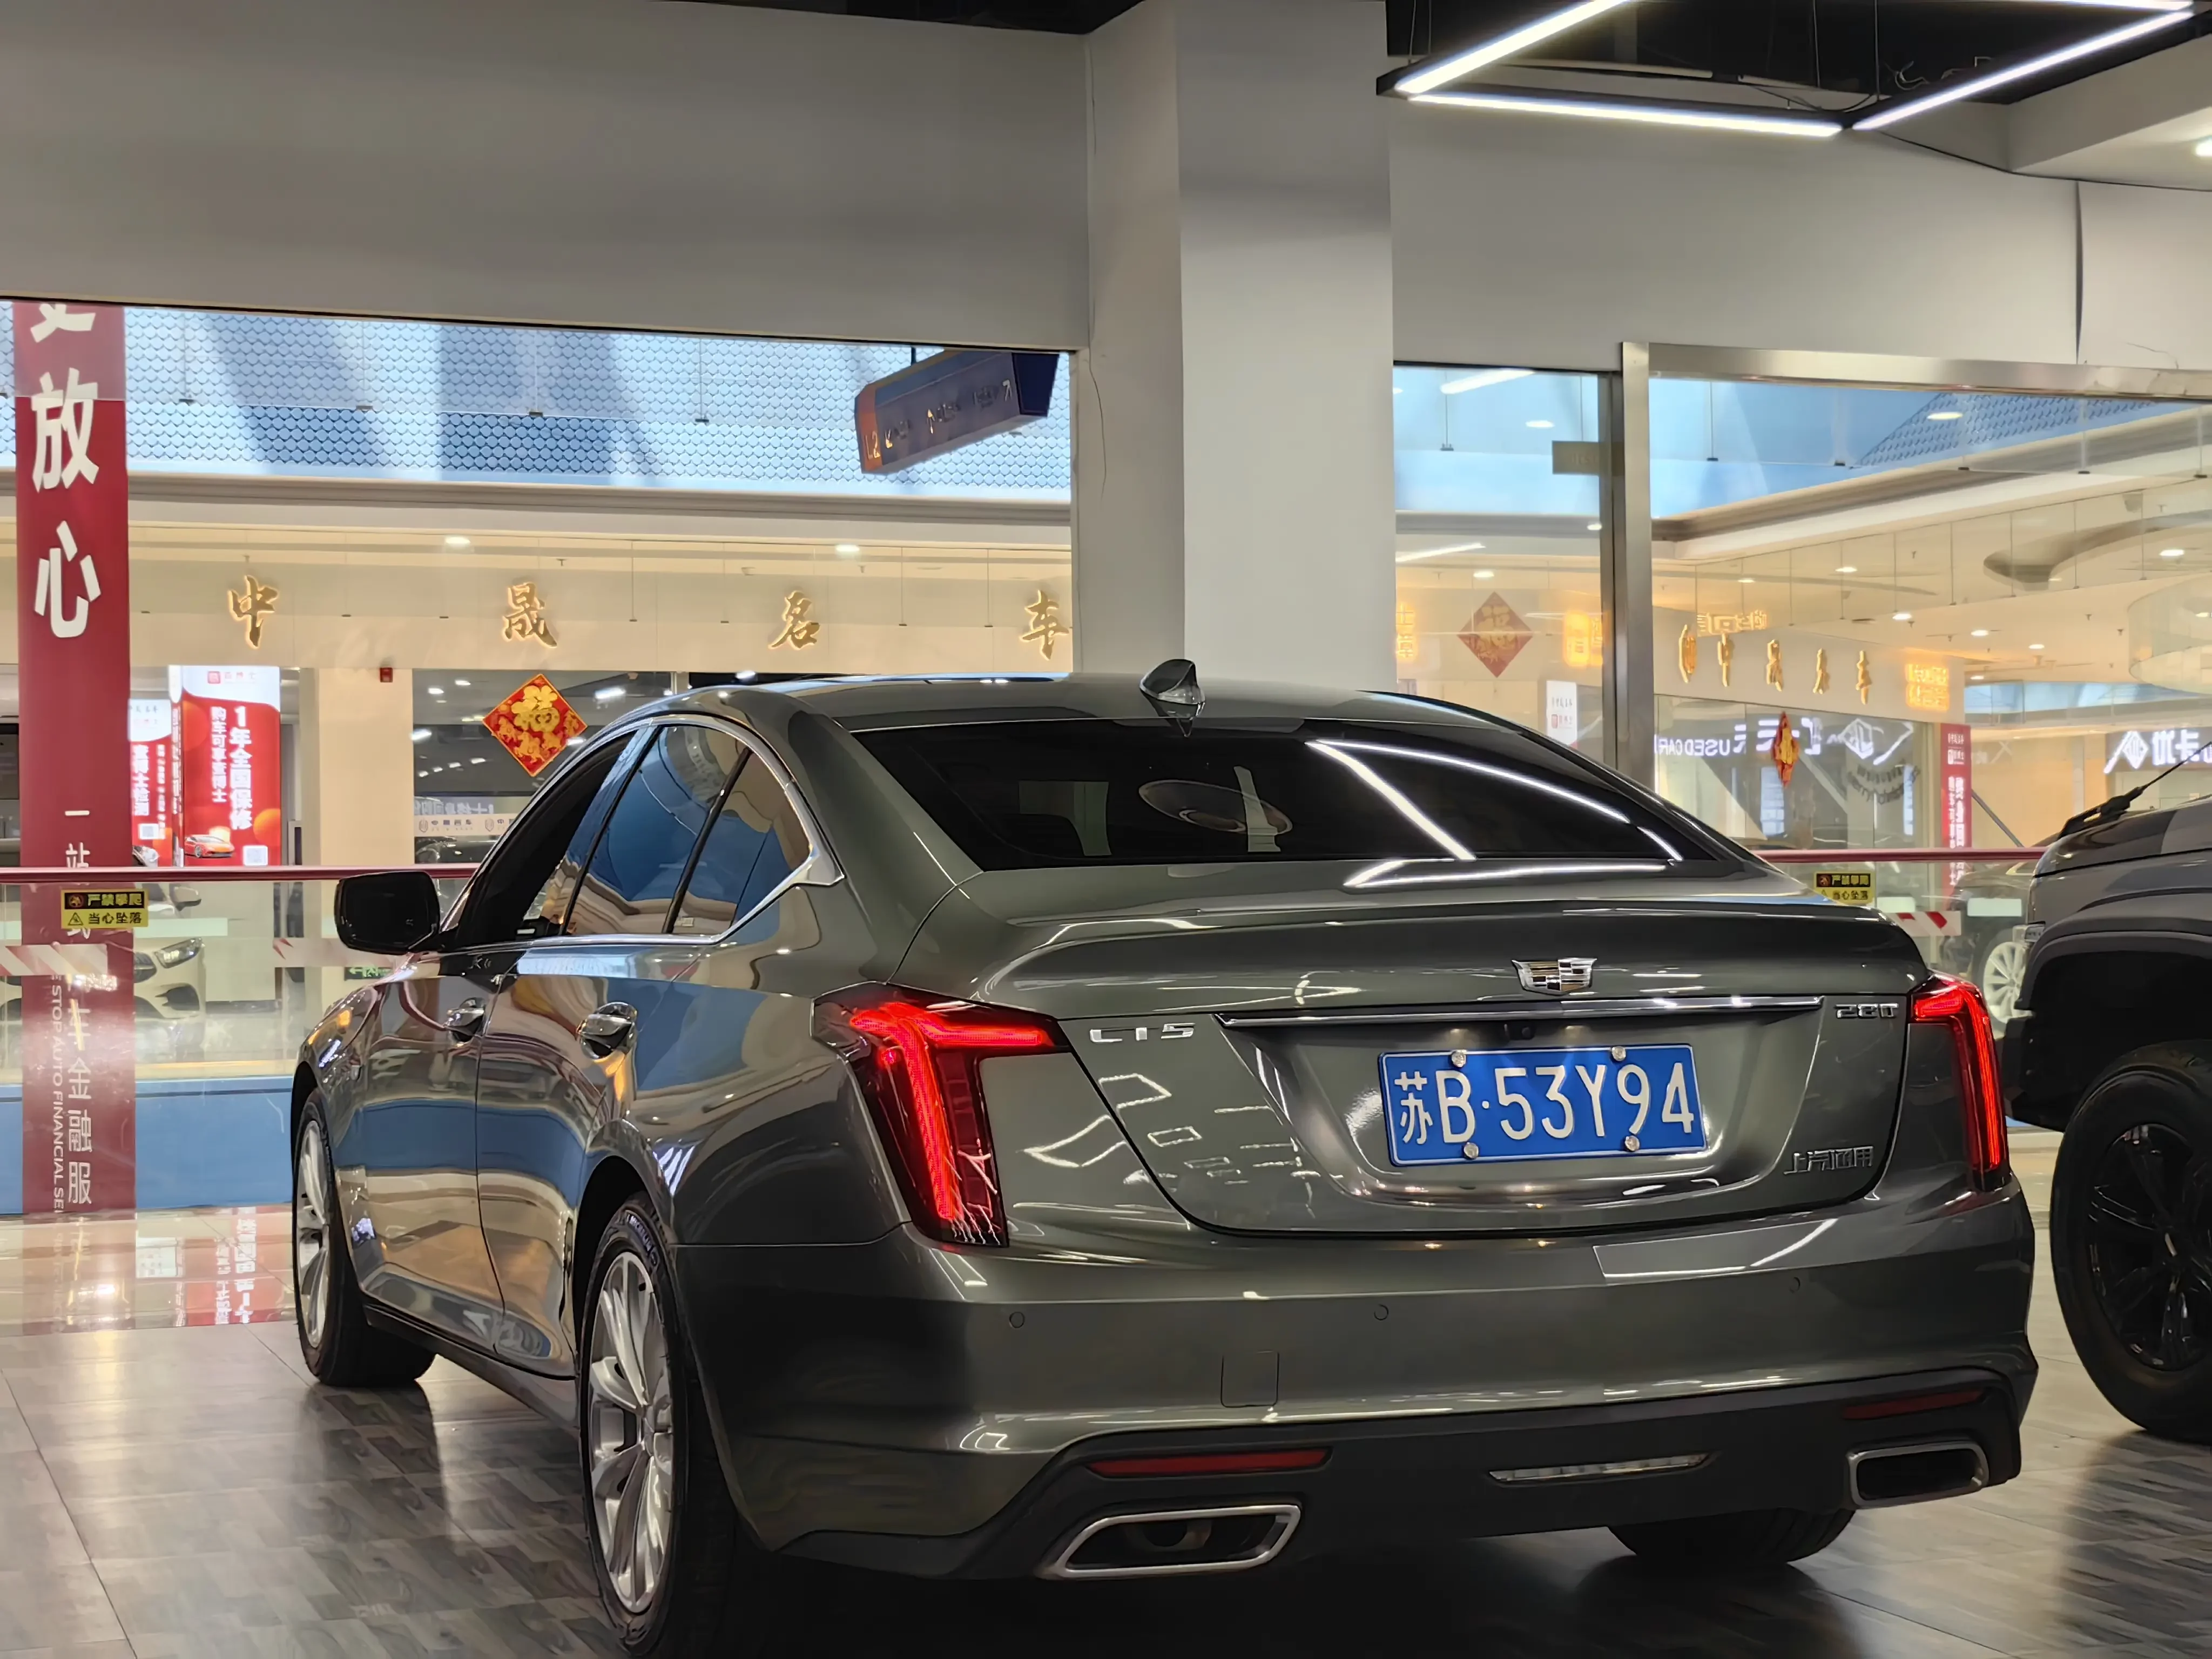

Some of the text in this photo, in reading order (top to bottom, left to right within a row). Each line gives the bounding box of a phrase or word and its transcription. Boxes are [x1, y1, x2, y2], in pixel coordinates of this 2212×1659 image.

[865, 431, 881, 460] L2
[229, 705, 253, 830] 1年全国保修
[88, 912, 142, 924] 当心坠落
[1090, 1022, 1196, 1043] CT5
[52, 985, 65, 1213] STOP AUTO FINANCIAL SE
[1394, 1062, 1694, 1144] 苏B·53Y94
[1783, 1145, 1874, 1175] 上汽通用
